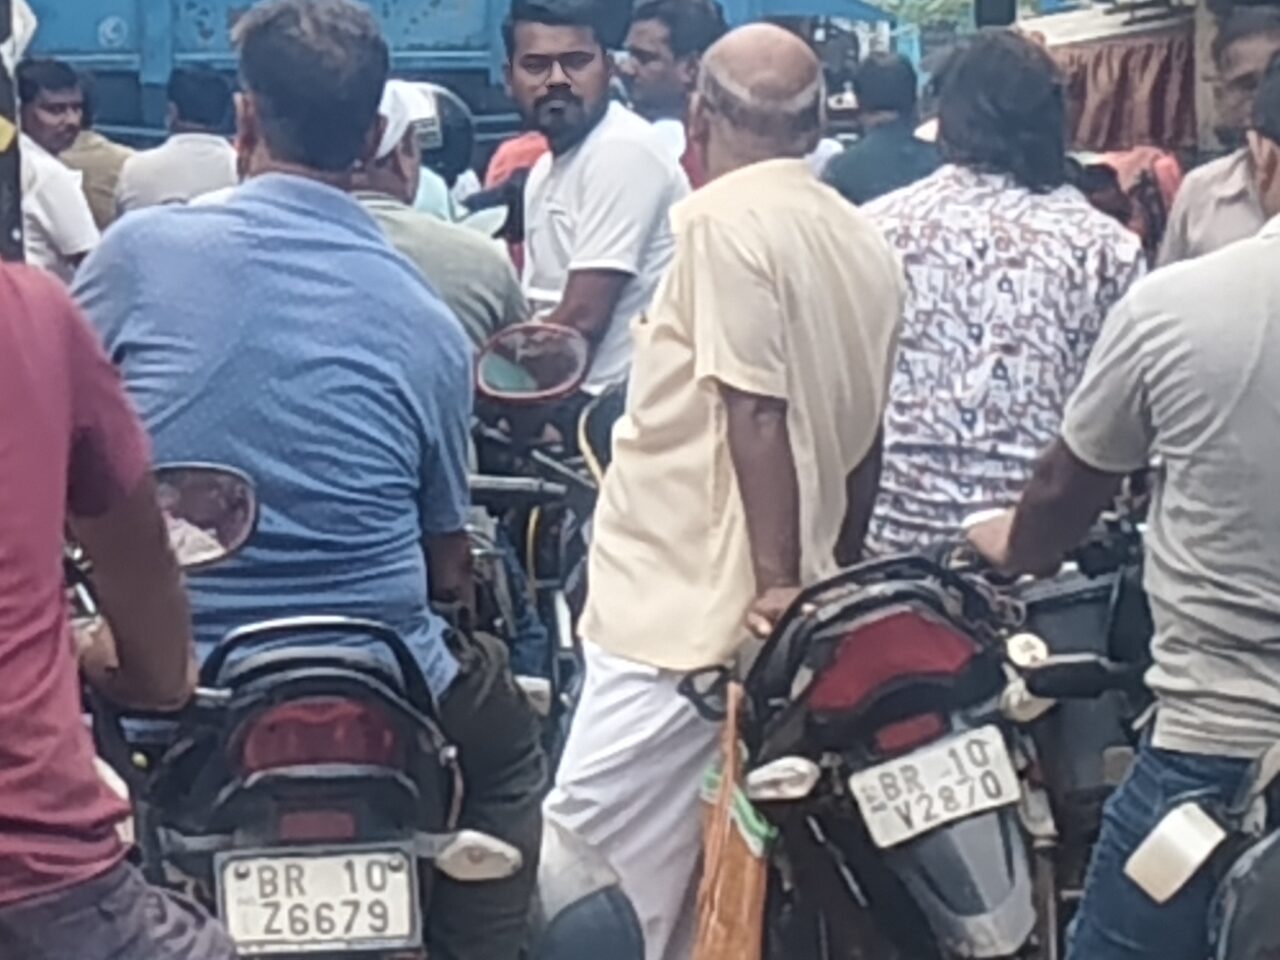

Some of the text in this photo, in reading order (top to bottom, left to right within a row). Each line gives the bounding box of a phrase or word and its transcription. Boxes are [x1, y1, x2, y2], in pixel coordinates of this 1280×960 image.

[877, 764, 925, 802] BR
[947, 738, 992, 777] 10
[256, 859, 388, 899] BR 10
[260, 898, 389, 936] Z6679
